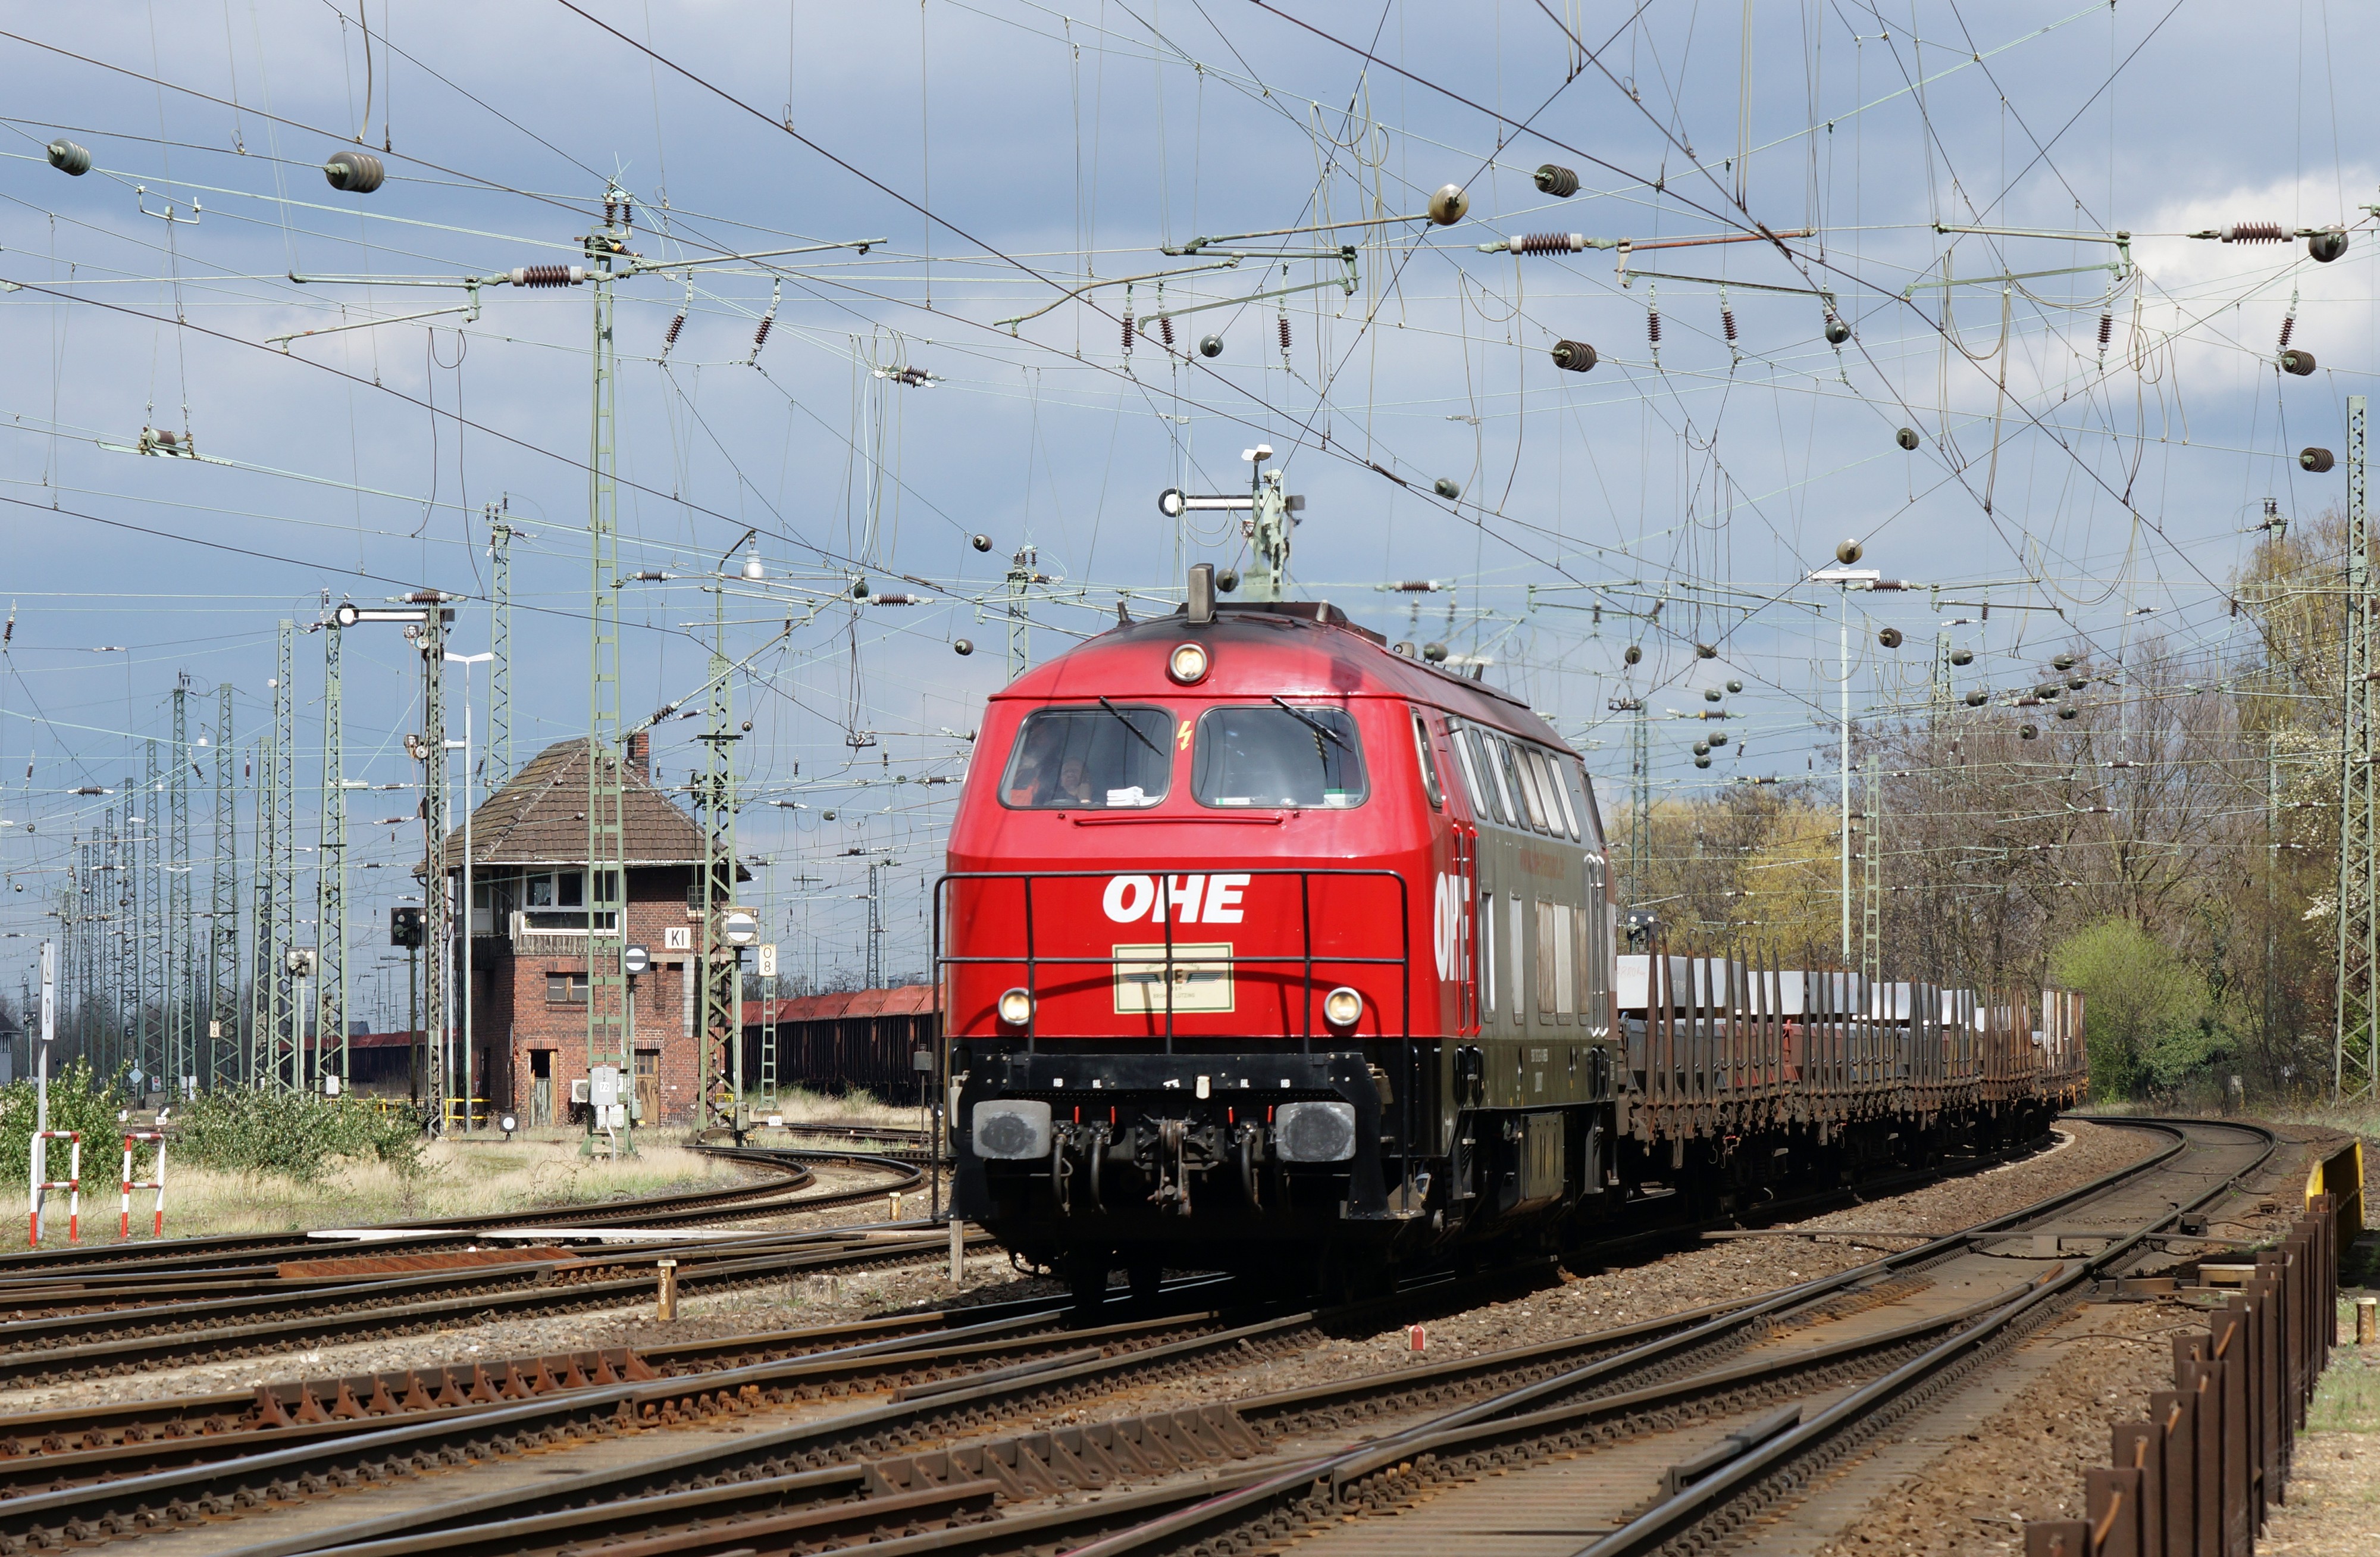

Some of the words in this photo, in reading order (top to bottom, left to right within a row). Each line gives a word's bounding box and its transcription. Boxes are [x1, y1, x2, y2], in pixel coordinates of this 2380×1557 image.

[1103, 874, 1251, 923] OHE
[1434, 871, 1470, 981] OHE
[1240, 1078, 1250, 1088] HL
[1280, 1078, 1291, 1088] HB
